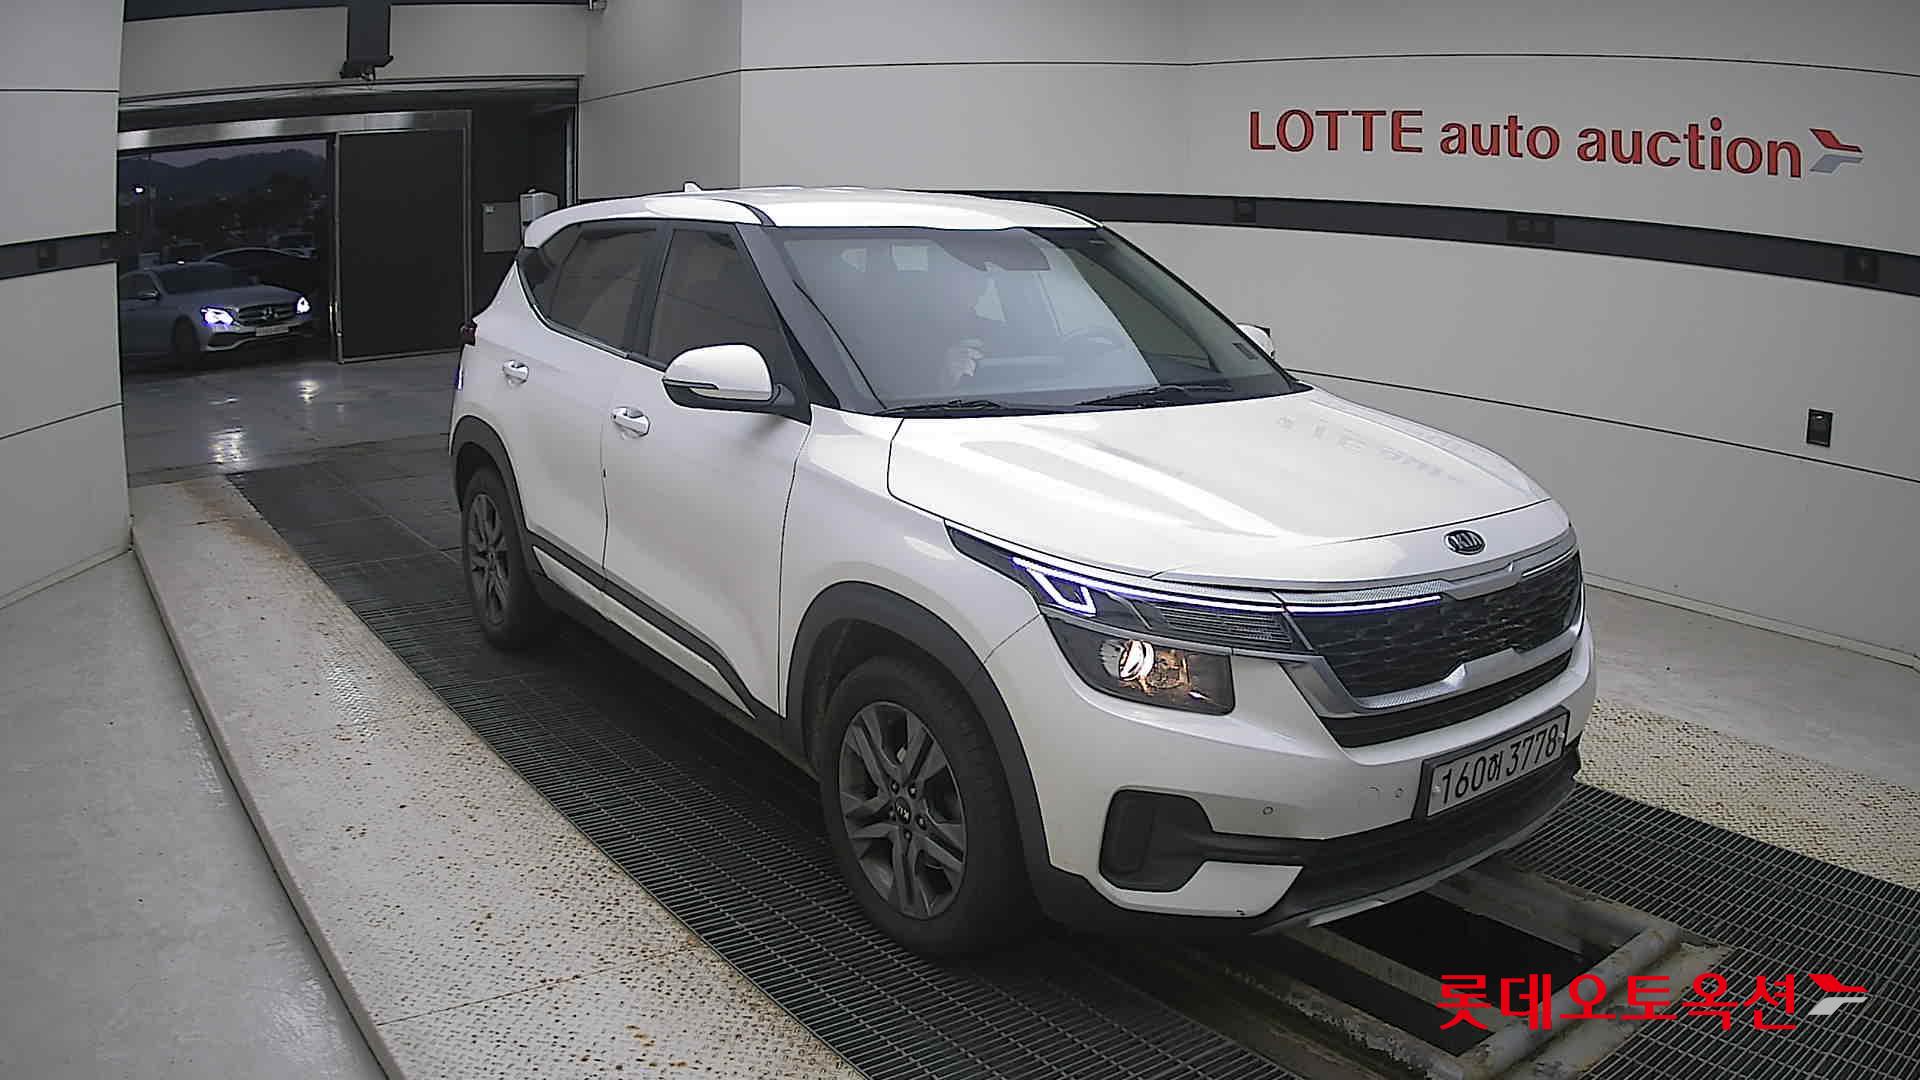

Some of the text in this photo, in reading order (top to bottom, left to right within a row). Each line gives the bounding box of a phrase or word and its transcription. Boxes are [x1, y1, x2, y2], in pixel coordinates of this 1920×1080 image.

[1249, 109, 1802, 178] LOTTE auto auction
